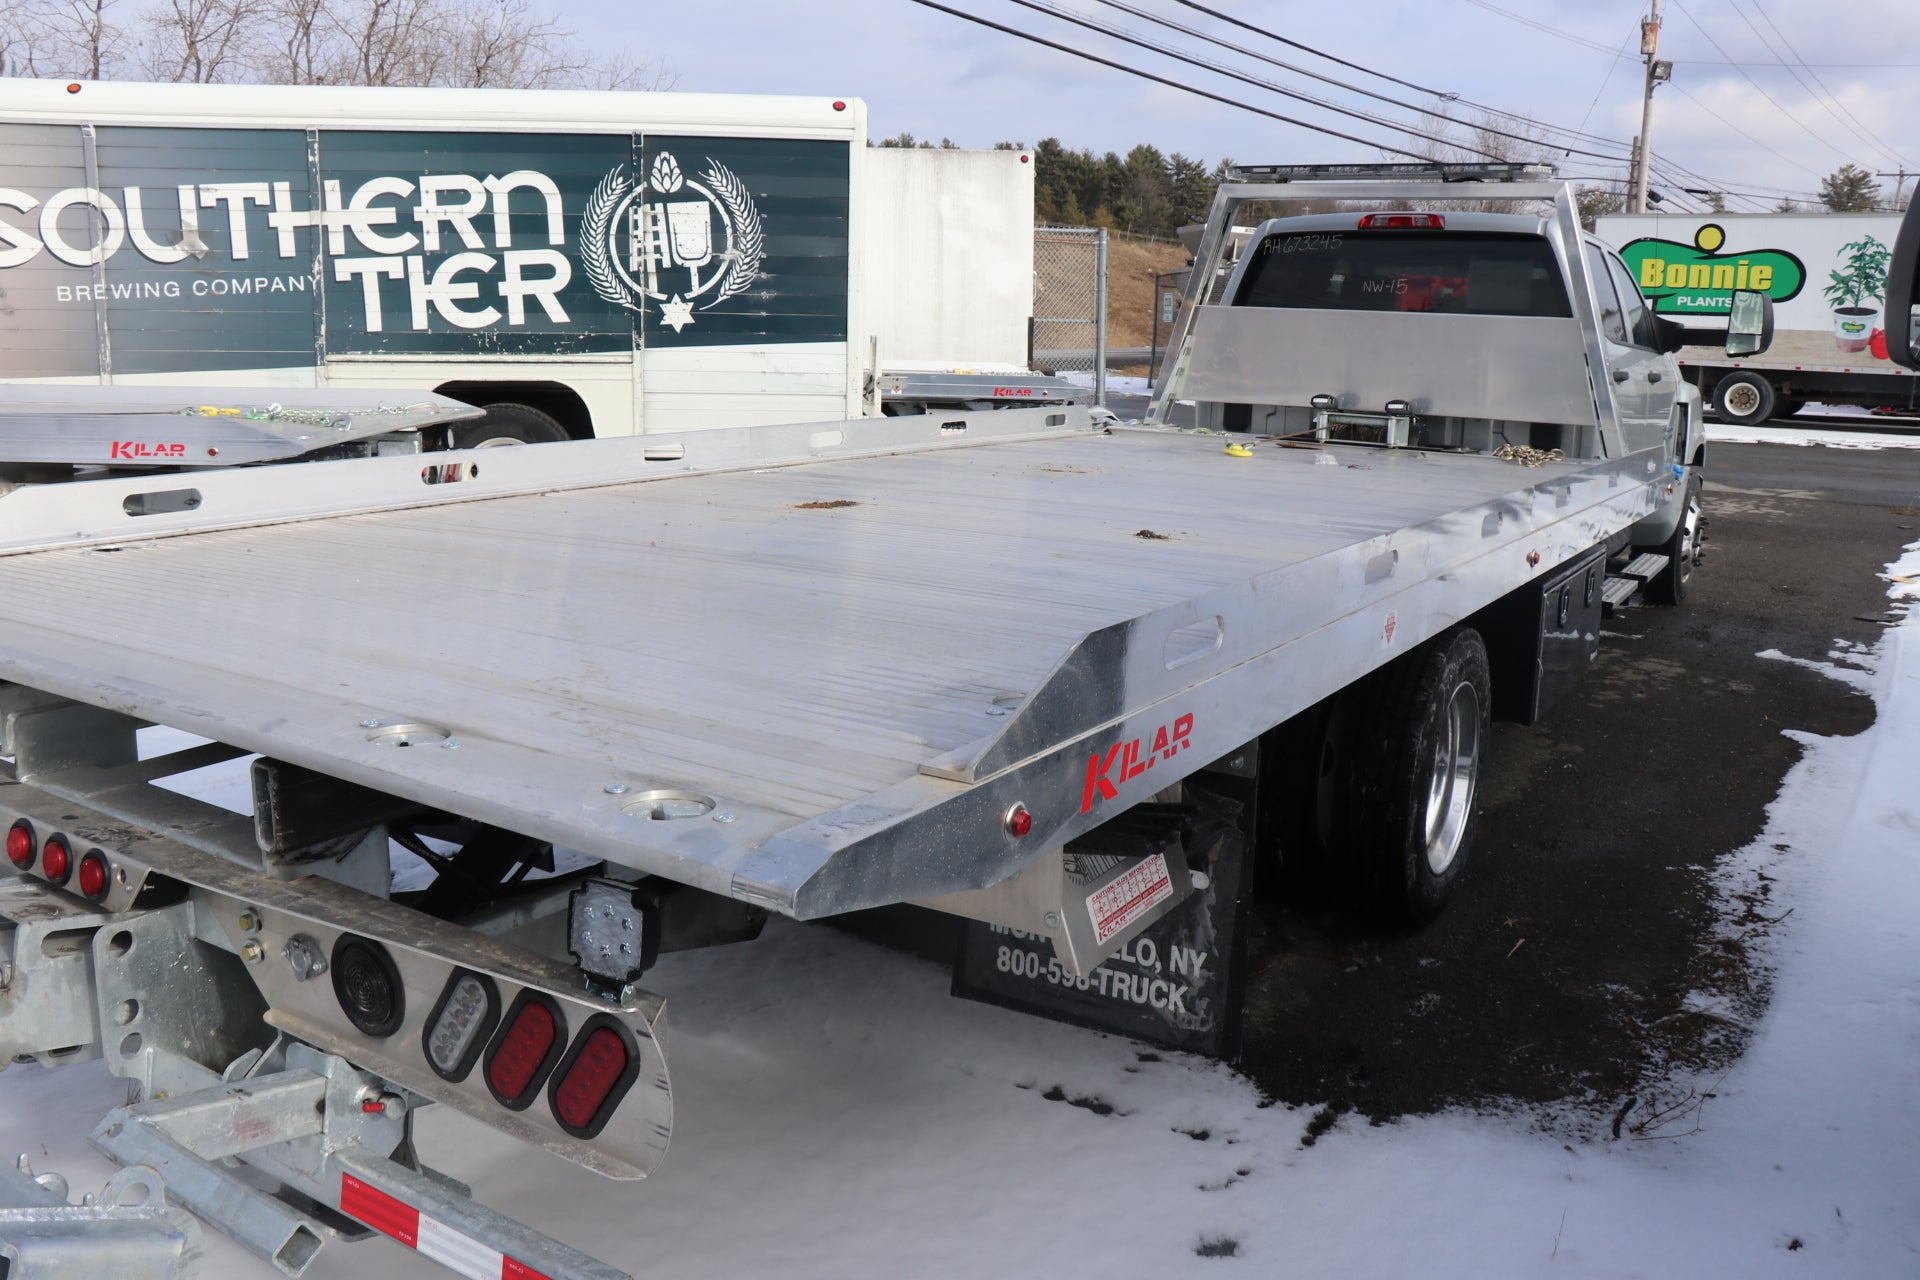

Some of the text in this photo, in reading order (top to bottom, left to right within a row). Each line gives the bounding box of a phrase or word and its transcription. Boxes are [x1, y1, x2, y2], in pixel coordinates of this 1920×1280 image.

[0, 170, 565, 268] SOUTHERN
[57, 275, 321, 302] BREWING COMPANY
[1363, 278, 1408, 294] NW-15
[1640, 258, 1773, 290] Bonnie
[334, 249, 572, 333] TIER
[993, 387, 1033, 397] KILAR
[111, 441, 186, 459] KILAR
[1080, 712, 1195, 815] KILAR
[1169, 945, 1208, 978] NY
